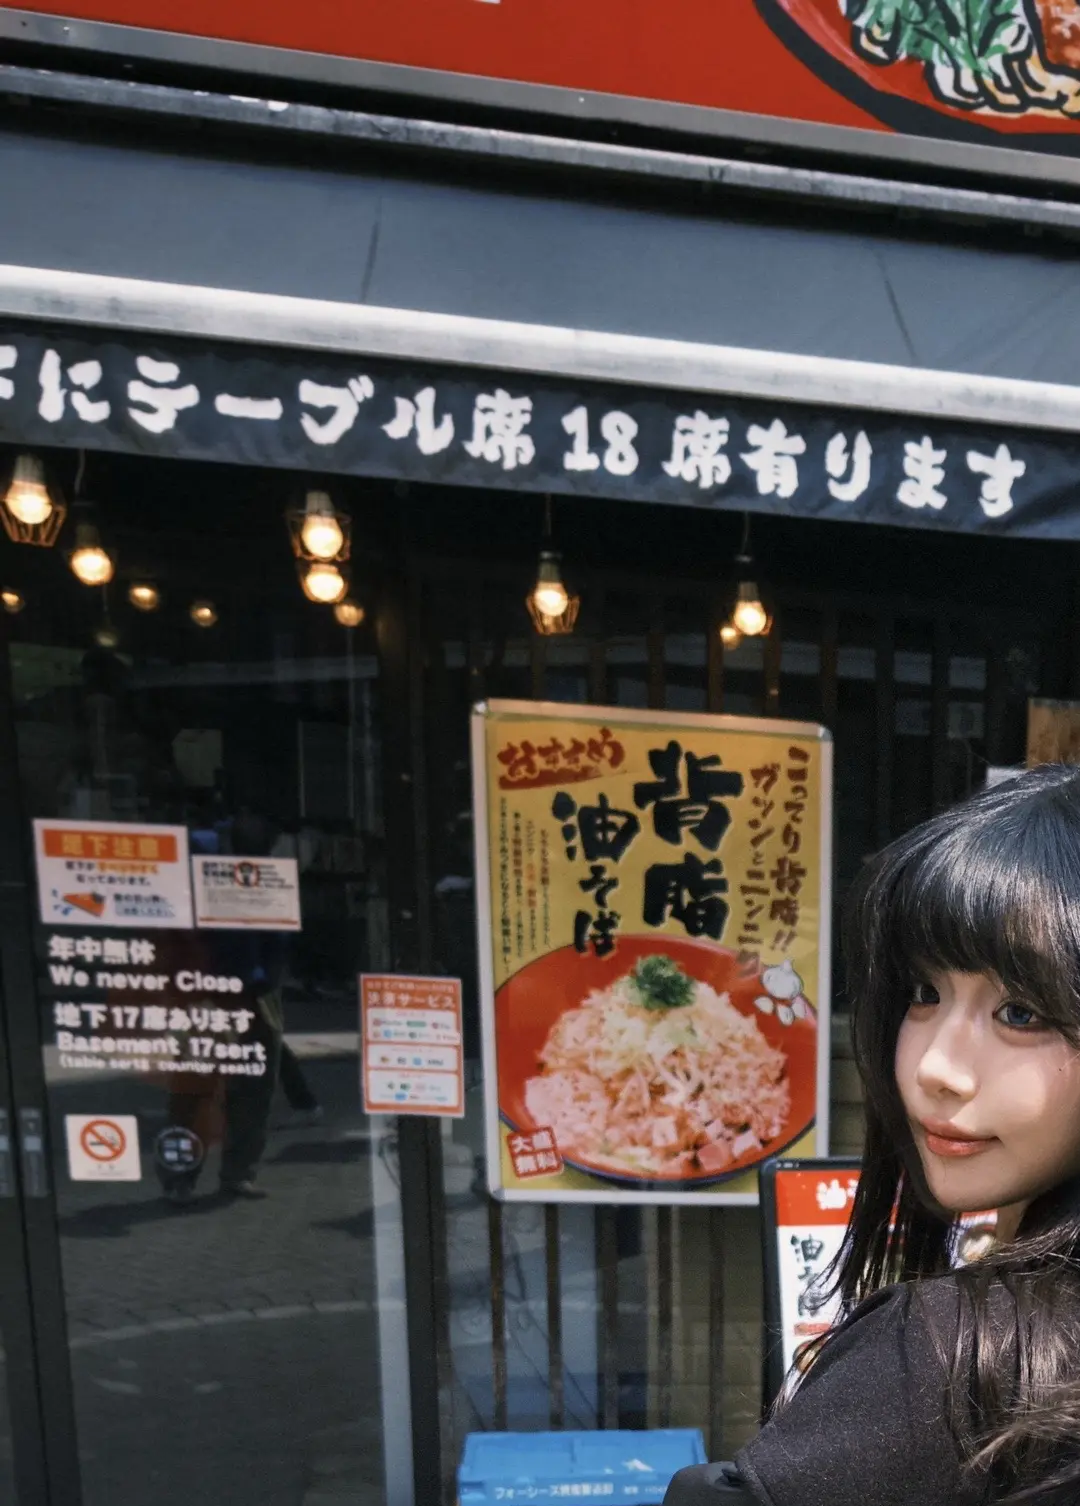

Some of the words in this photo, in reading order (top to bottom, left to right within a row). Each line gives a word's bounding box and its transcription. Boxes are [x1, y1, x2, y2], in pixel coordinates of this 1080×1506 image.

[497, 727, 625, 780] おすすめ
[633, 740, 743, 940] 背脂
[552, 792, 641, 955] 油そば
[48, 935, 156, 965] 年中無休
[49, 963, 89, 988] We
[96, 970, 169, 991] never
[175, 970, 244, 993] Close
[56, 1030, 181, 1056] Basement
